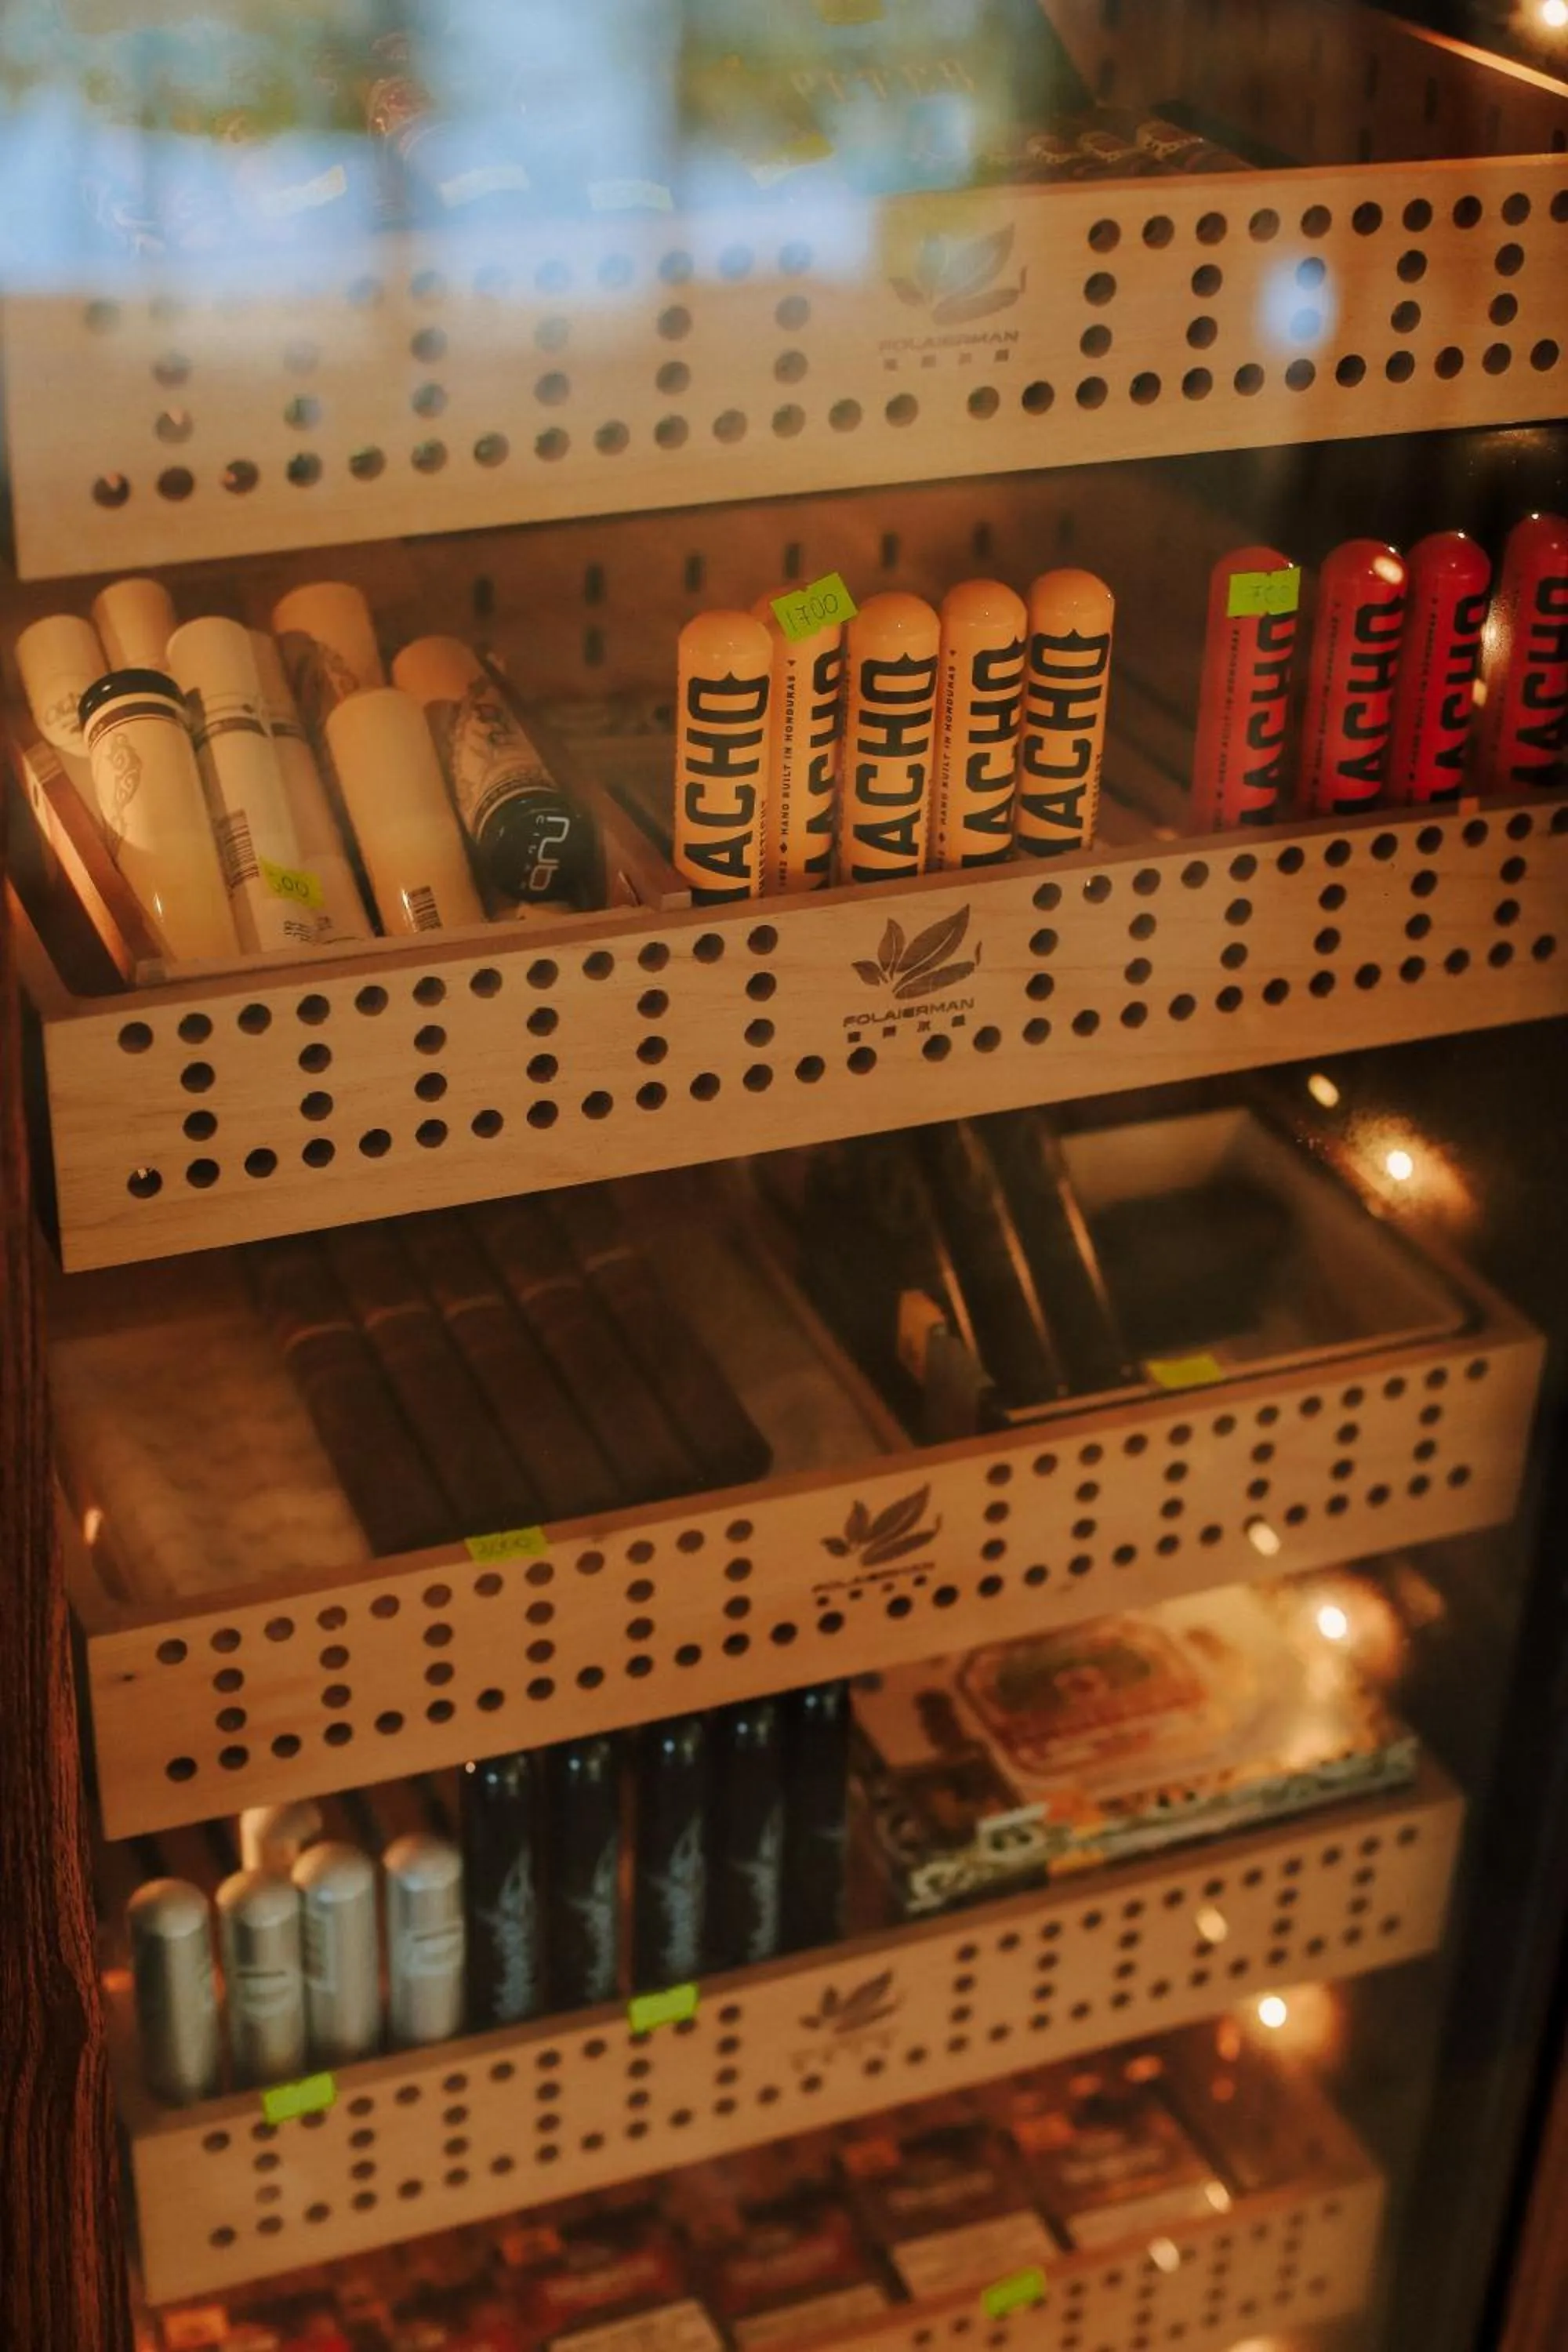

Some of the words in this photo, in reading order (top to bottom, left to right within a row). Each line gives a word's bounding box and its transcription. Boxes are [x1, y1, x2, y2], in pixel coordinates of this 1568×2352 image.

[785, 593, 839, 632] 1700
[785, 675, 797, 741] HONDURAS
[785, 747, 793, 759] IN
[782, 764, 793, 797] BUILT
[781, 804, 790, 836] HAND
